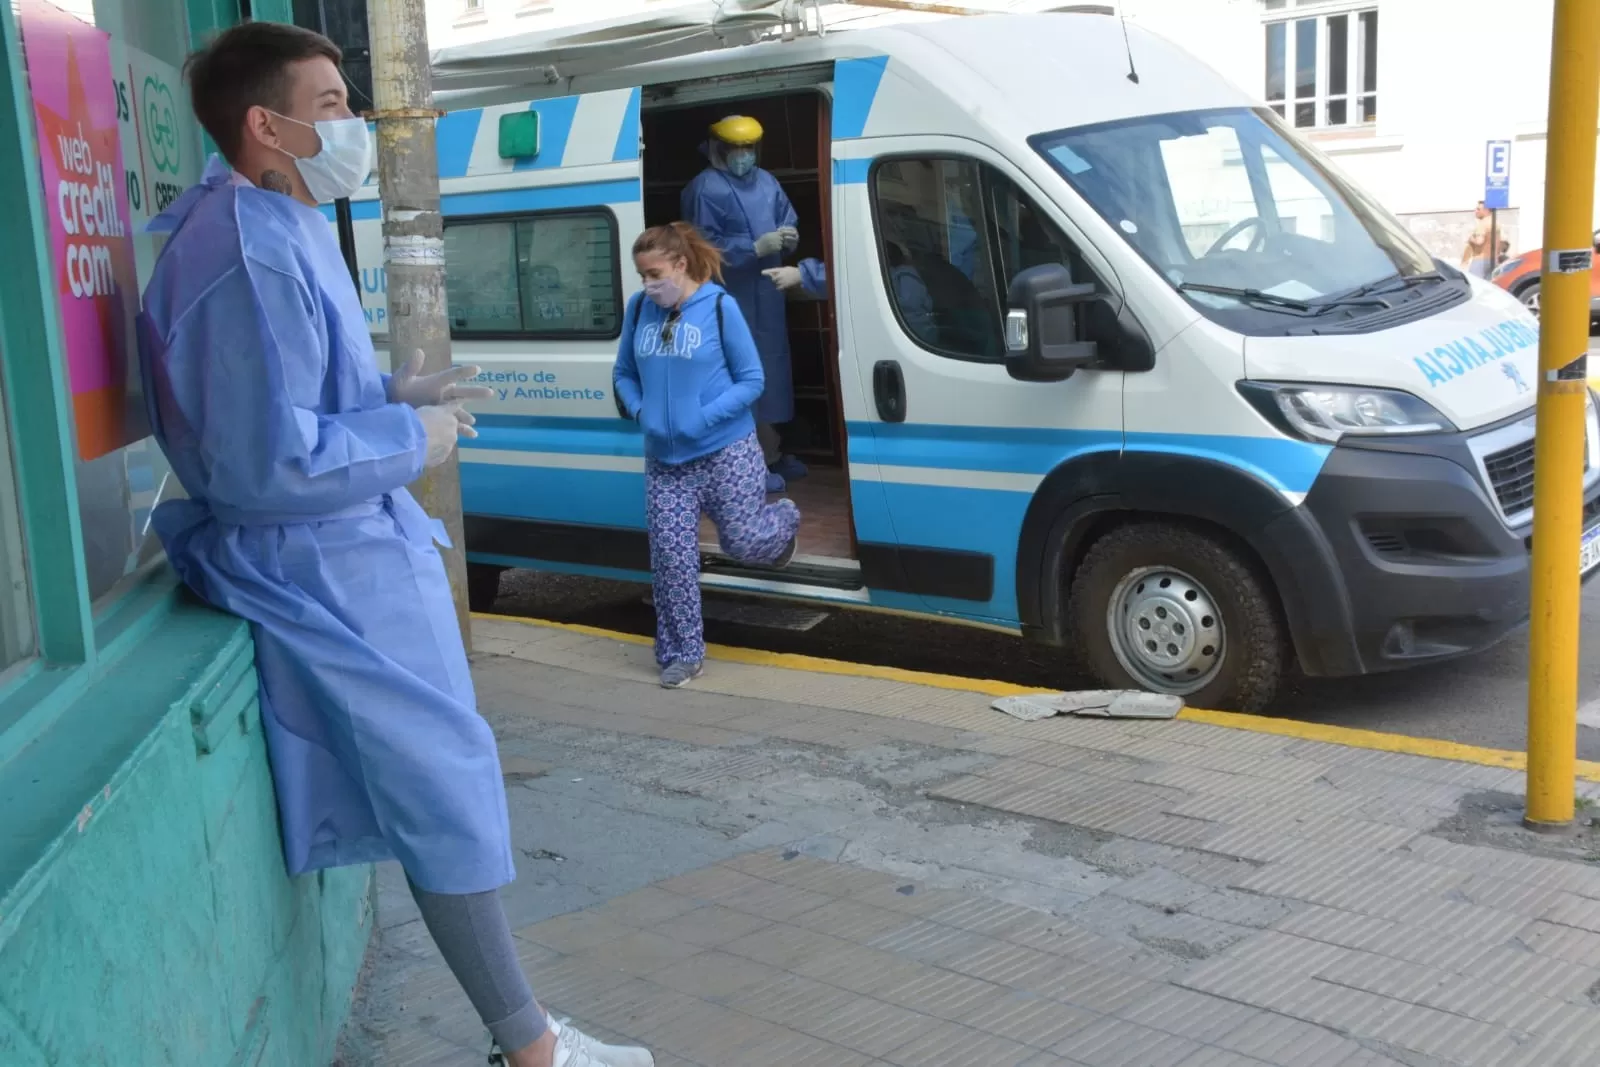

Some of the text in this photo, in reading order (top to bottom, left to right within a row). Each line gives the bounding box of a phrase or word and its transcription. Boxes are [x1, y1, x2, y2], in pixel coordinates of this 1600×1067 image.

[57, 121, 93, 175] web
[1493, 147, 1504, 173] E
[67, 244, 115, 298] com
[639, 322, 701, 360] GAP
[533, 371, 556, 383] de
[498, 387, 605, 401] y Ambiente
